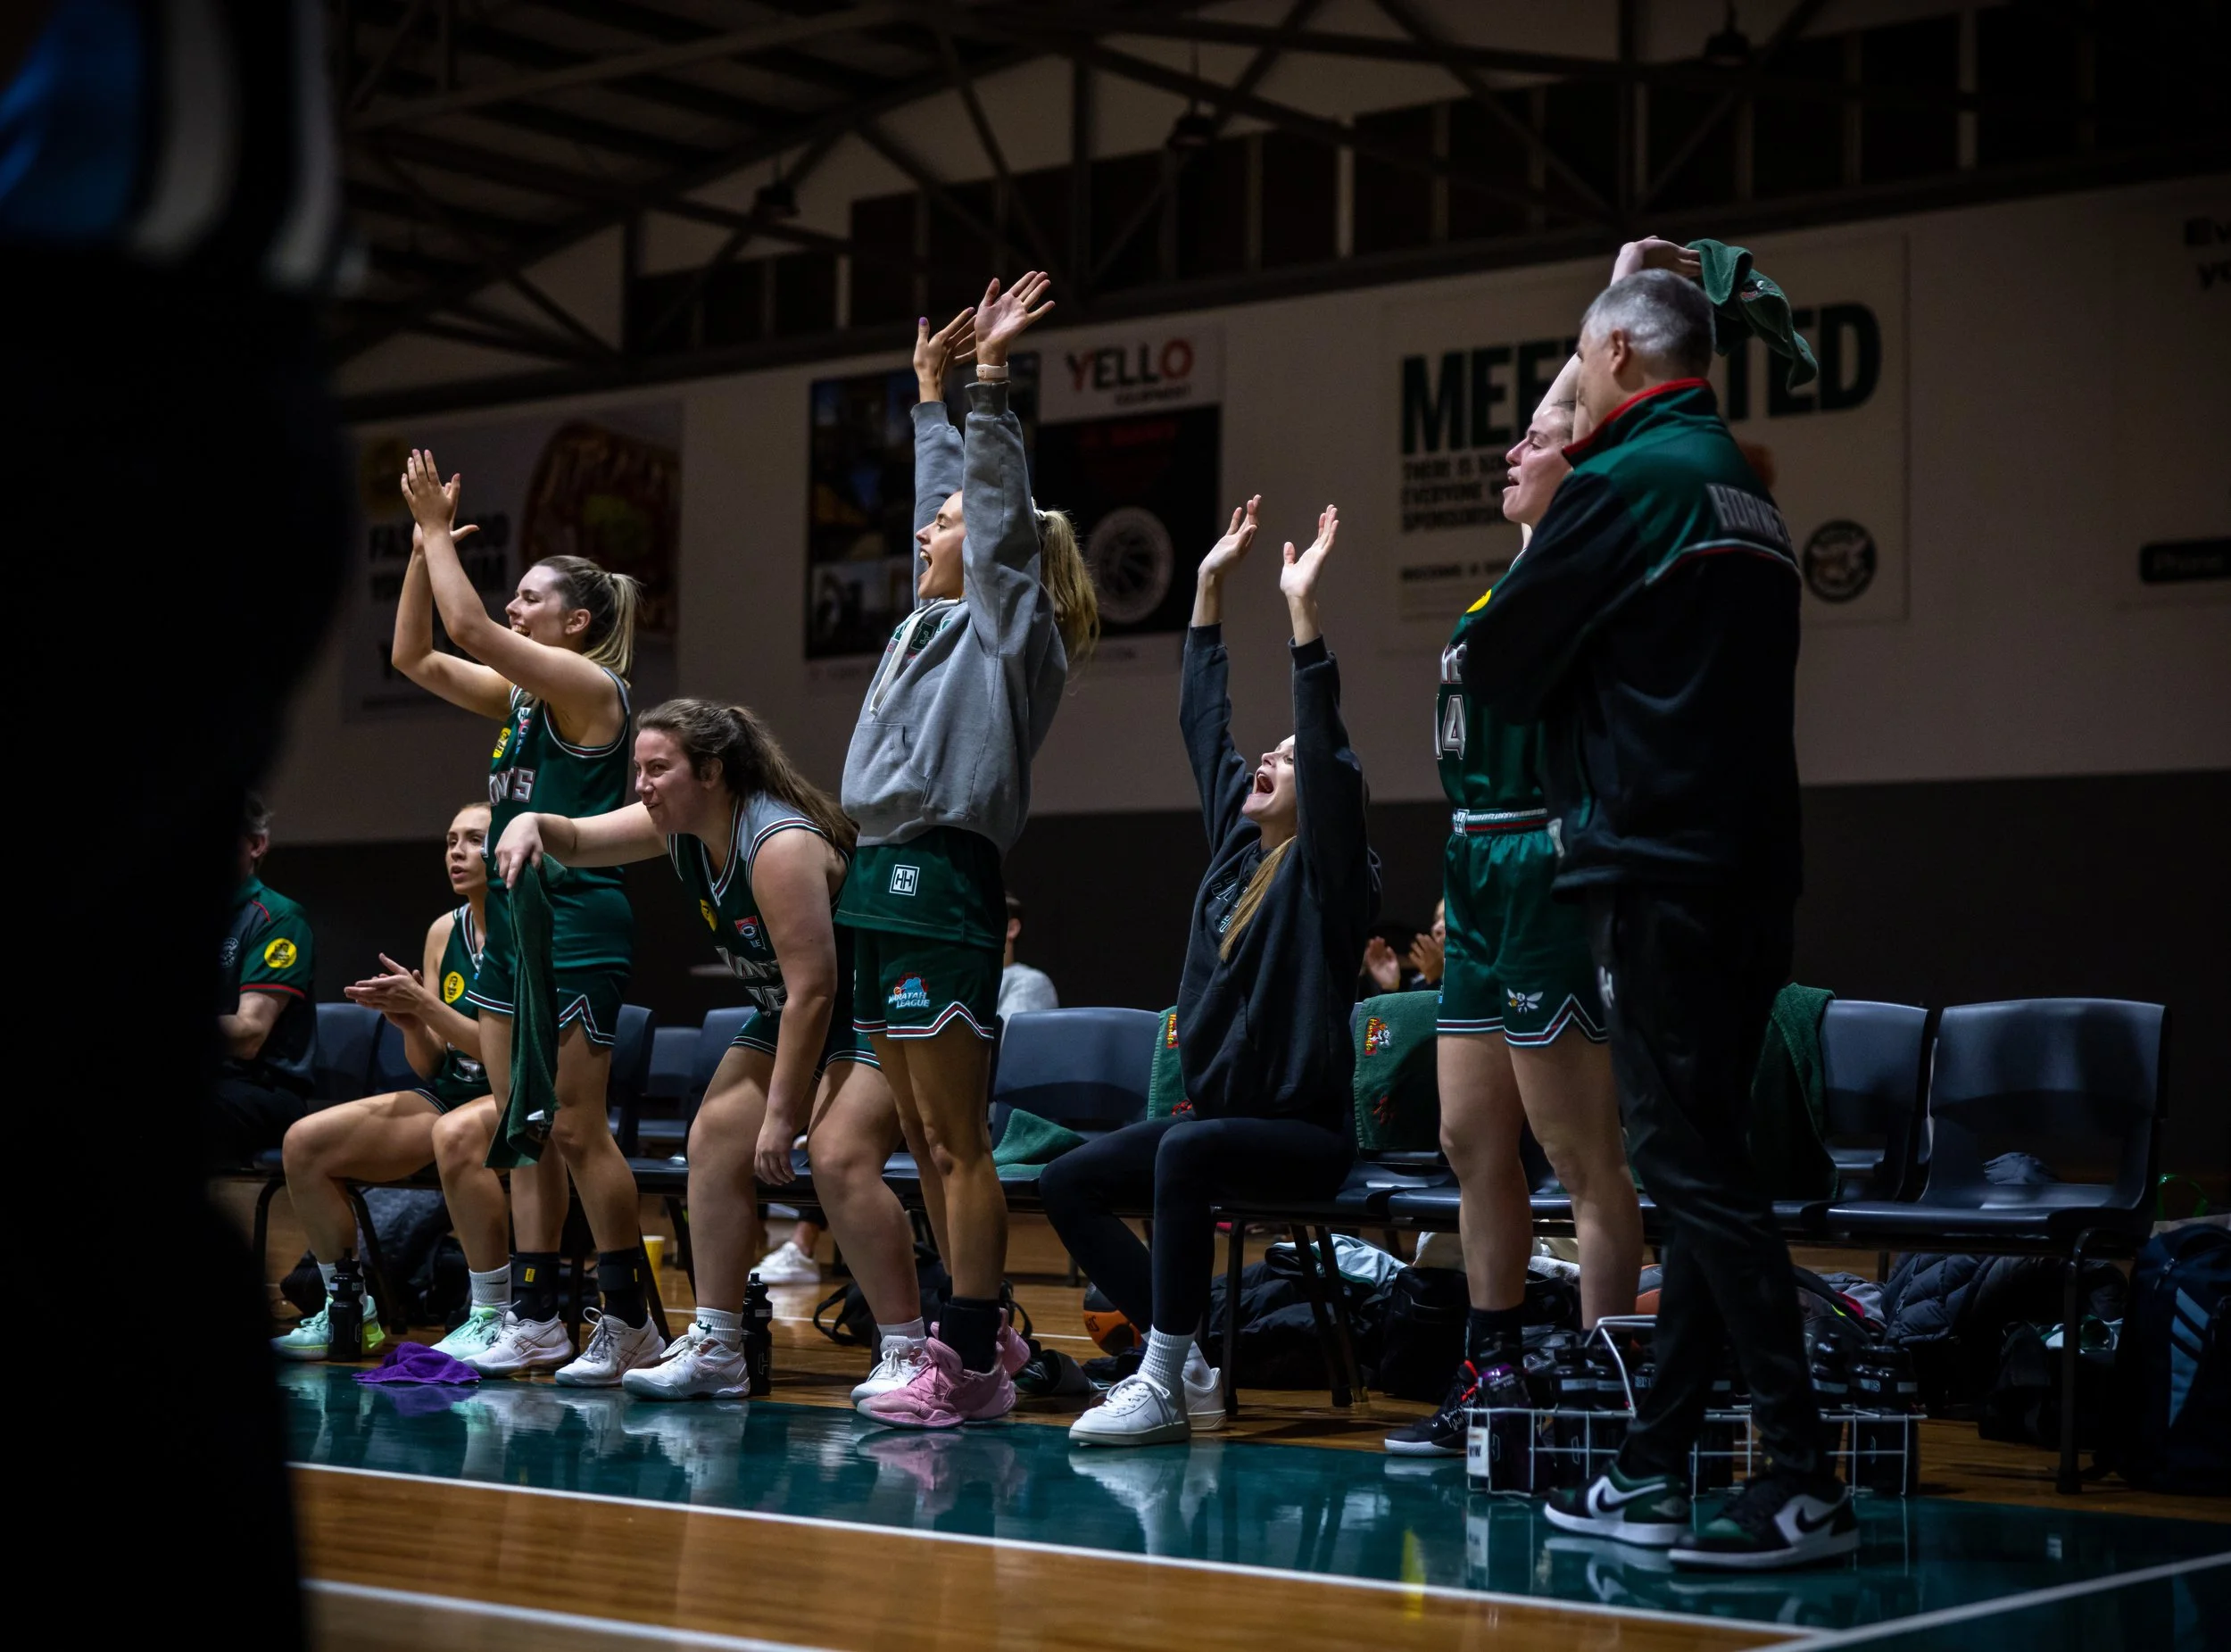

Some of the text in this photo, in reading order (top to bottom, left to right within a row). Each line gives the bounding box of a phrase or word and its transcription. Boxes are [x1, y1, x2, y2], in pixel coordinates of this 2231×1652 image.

[1066, 338, 1194, 391] YELLO
[1403, 337, 1578, 453] MEE
[896, 999, 931, 1009] LEAGUE
